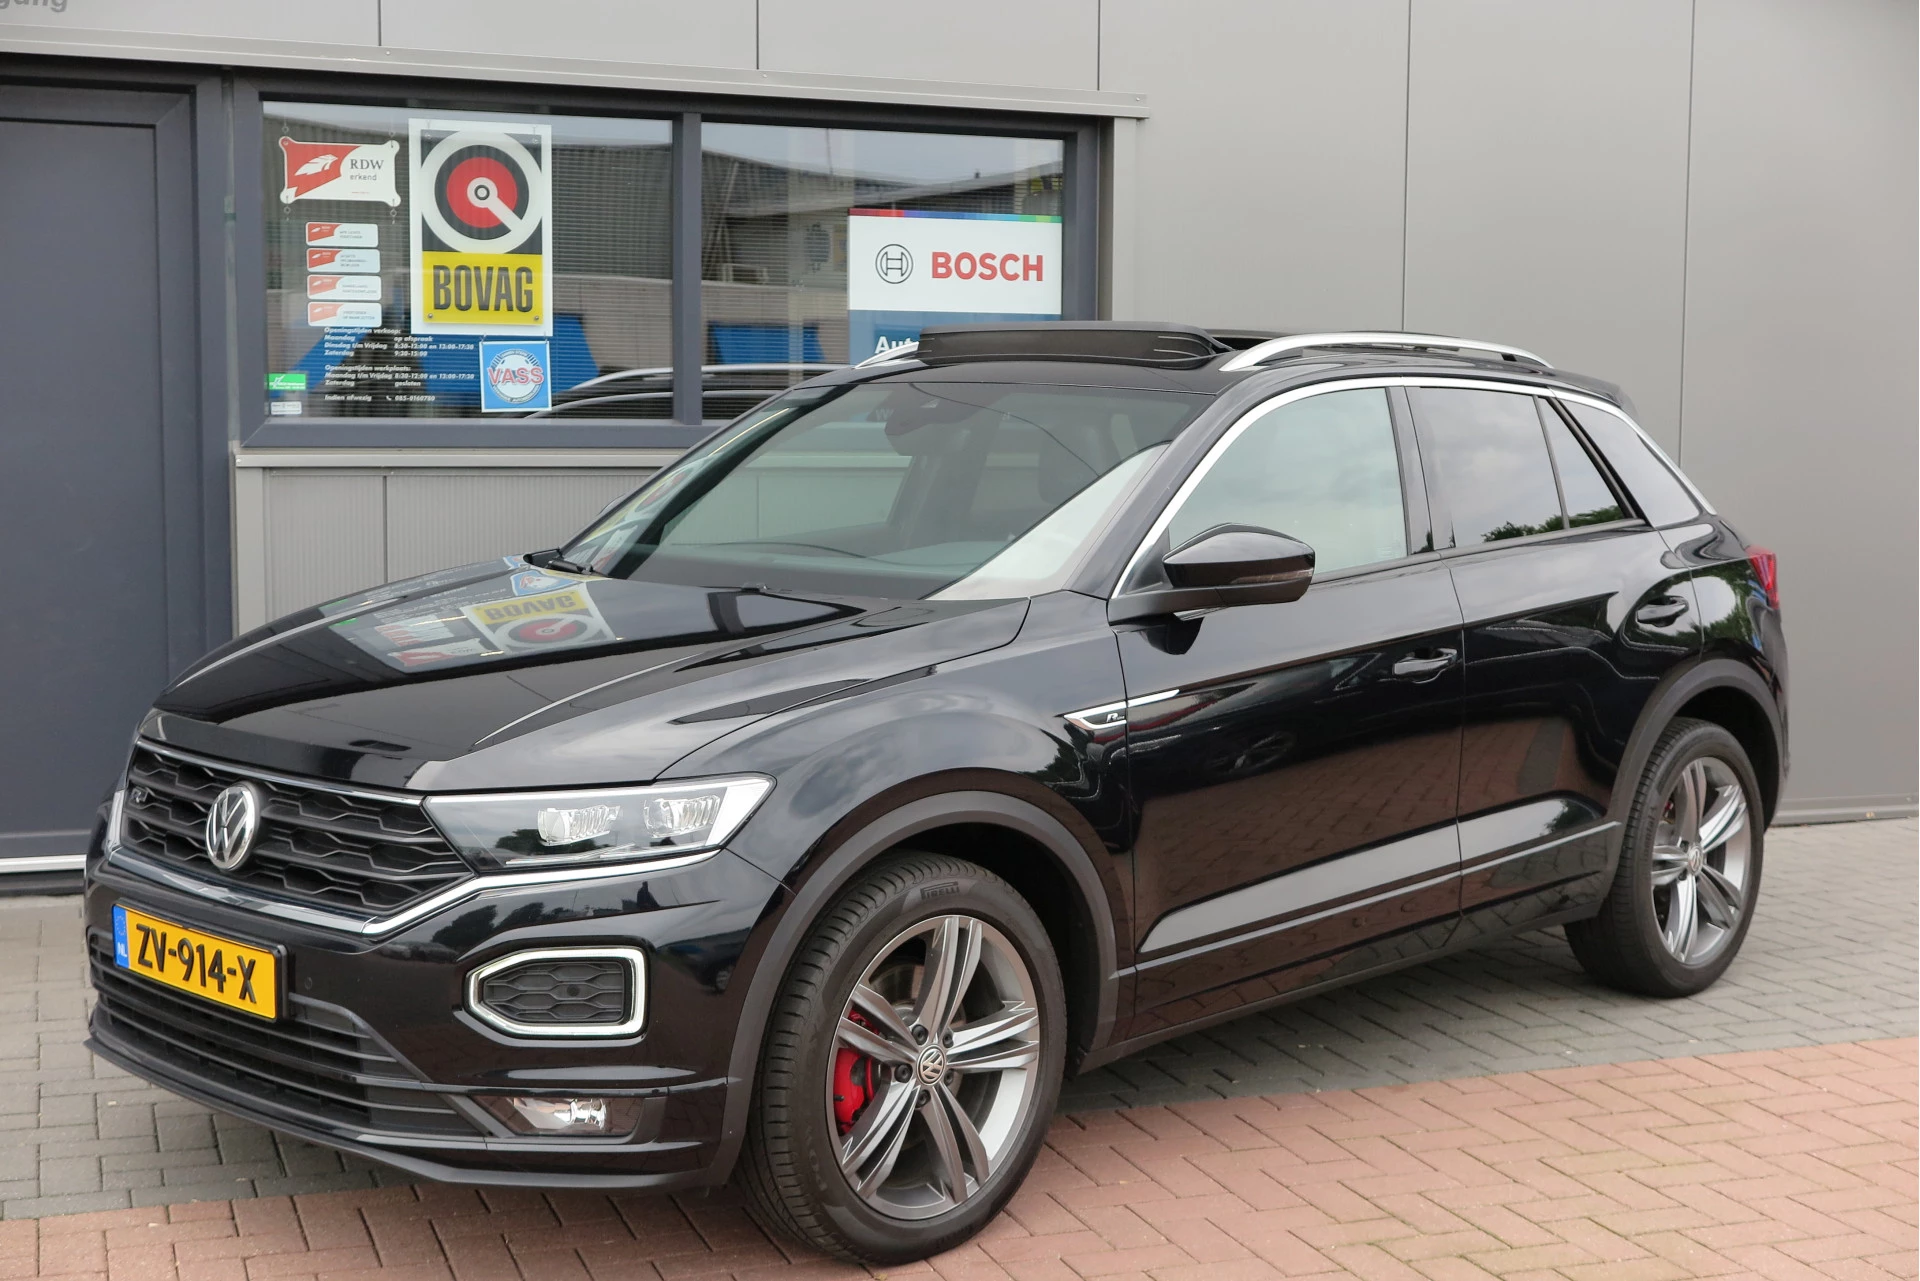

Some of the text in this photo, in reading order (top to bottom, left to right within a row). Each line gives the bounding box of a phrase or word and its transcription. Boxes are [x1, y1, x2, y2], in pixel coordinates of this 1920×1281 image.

[349, 158, 384, 170] RDW
[931, 251, 1043, 282] BOSCH
[432, 264, 534, 313] BOVAG
[373, 327, 401, 335] verkoop:
[324, 334, 356, 342] Maandag
[364, 342, 388, 350] Vrijdag
[324, 364, 373, 372] Openingstijden
[369, 372, 393, 380] Vrijdag
[488, 366, 544, 385] VASS
[346, 394, 372, 402] afwezig
[136, 922, 257, 1005] ZV-914-X
